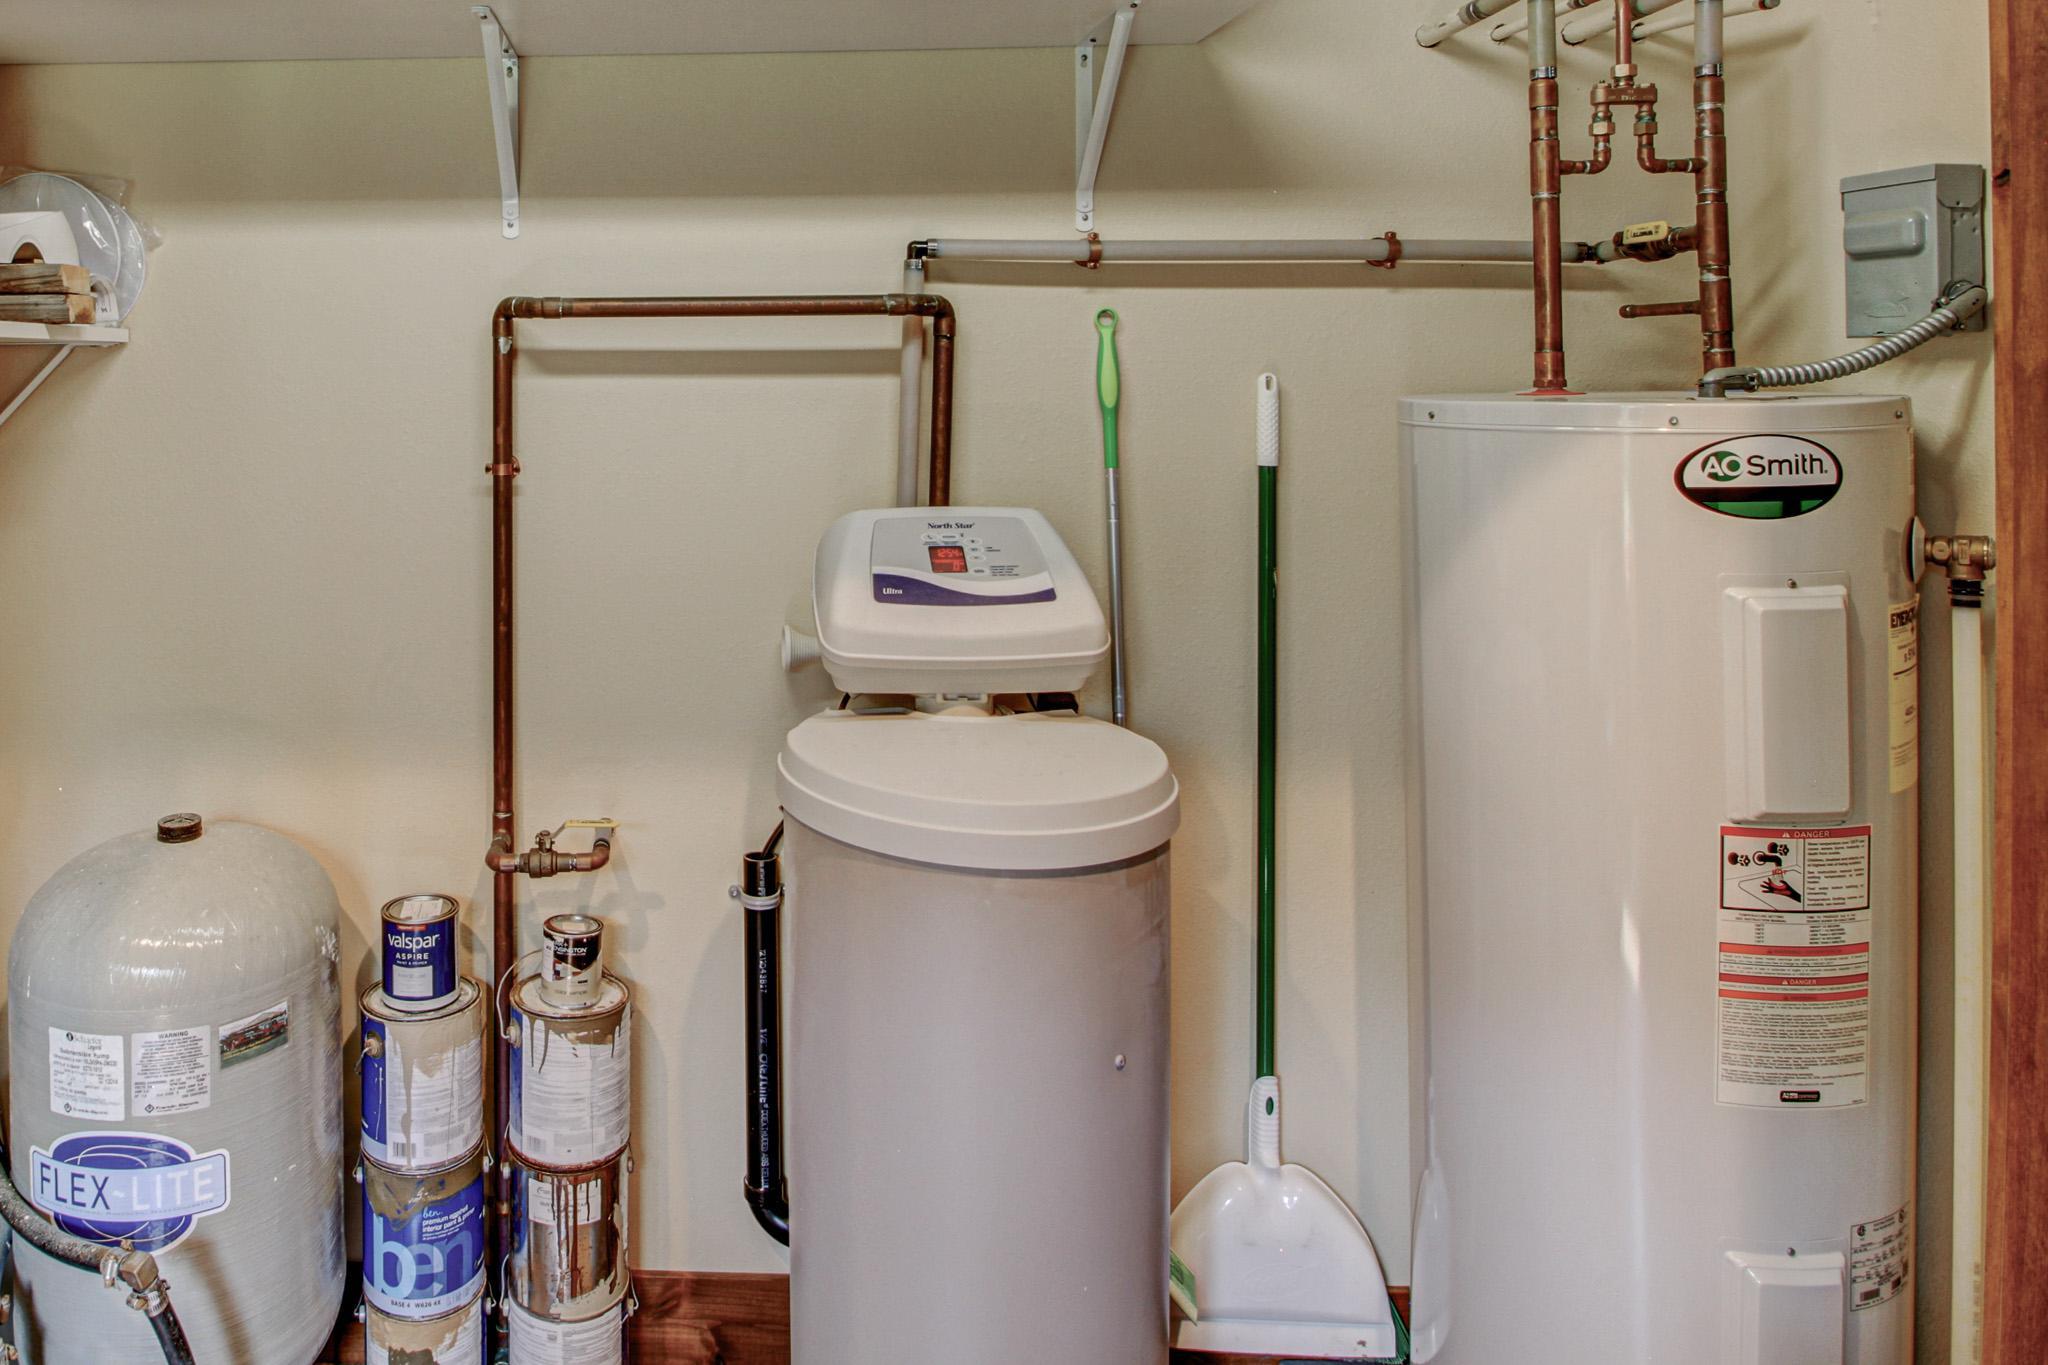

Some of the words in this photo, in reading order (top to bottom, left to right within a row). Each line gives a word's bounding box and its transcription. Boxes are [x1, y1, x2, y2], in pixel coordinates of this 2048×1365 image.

[1747, 453, 1823, 476] Smith
[882, 587, 903, 595] Ultra
[388, 932, 440, 953] valspar
[158, 1030, 189, 1039] WARNING
[373, 1212, 473, 1299] ben
